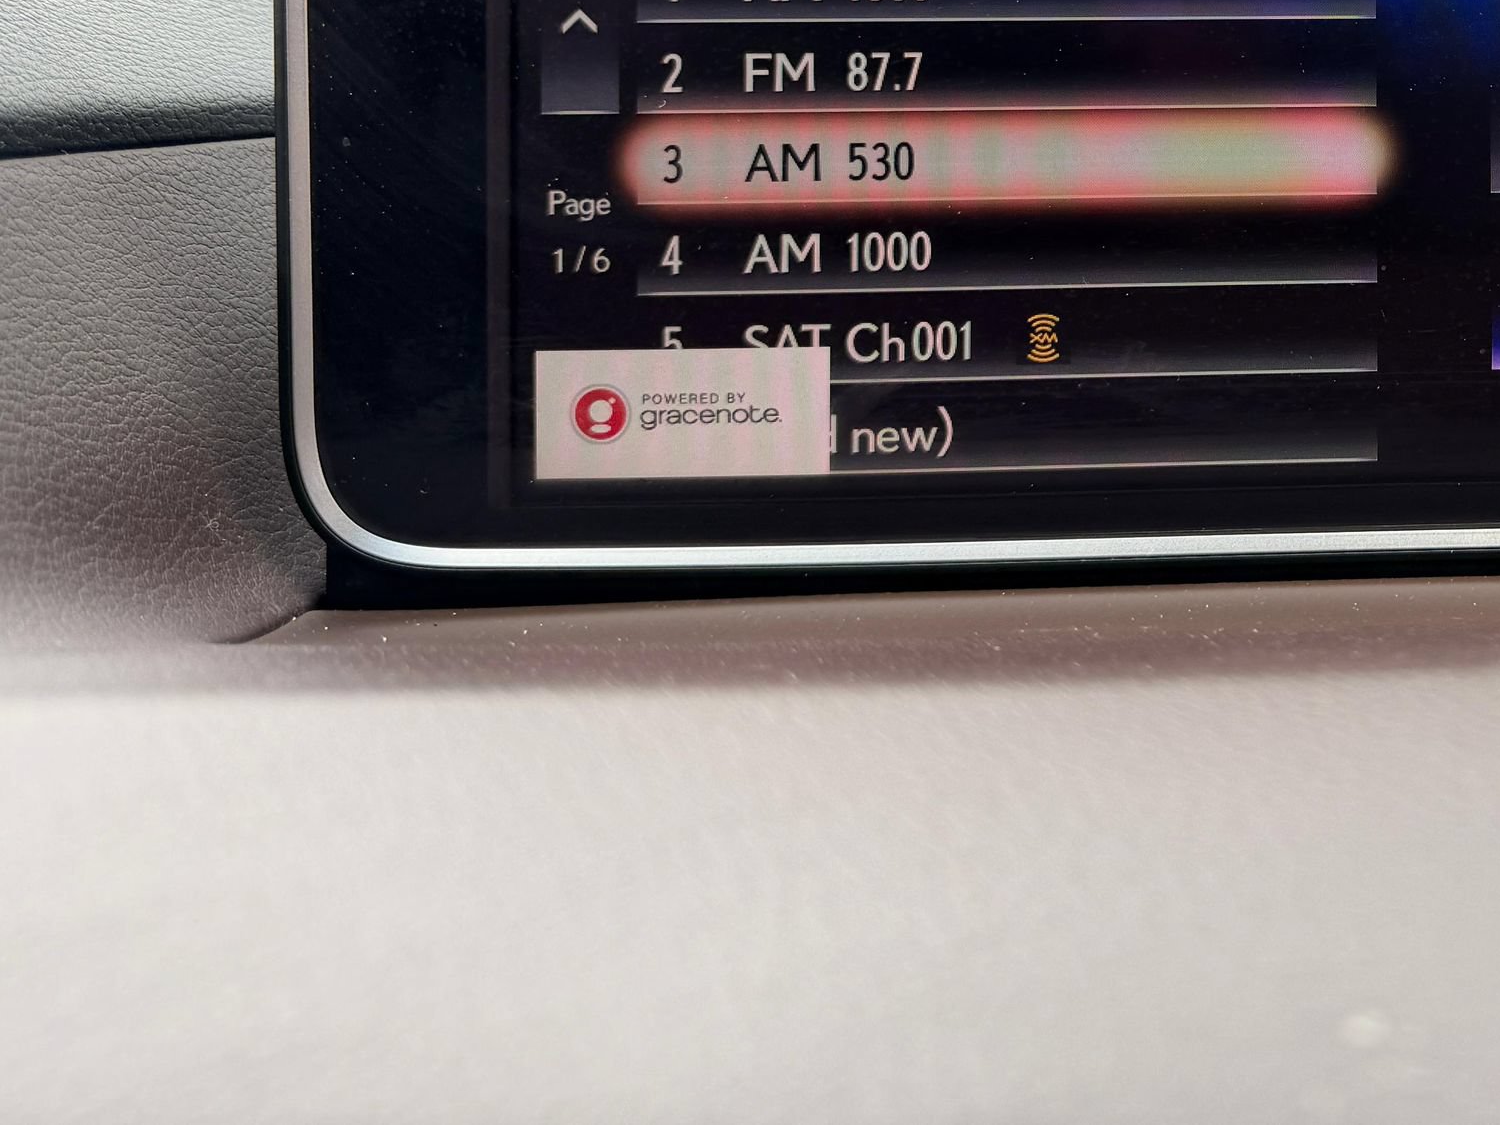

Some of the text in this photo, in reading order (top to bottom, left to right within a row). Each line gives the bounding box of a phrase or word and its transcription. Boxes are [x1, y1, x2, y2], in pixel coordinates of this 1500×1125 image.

[661, 51, 924, 93] 2 FM 87.7
[662, 141, 916, 184] 3 AM 530
[546, 190, 612, 222] Page
[660, 230, 932, 275] 4 AM 1000
[743, 323, 832, 349] SAT
[642, 391, 746, 405] POWERED BY
[850, 405, 954, 458] new)
